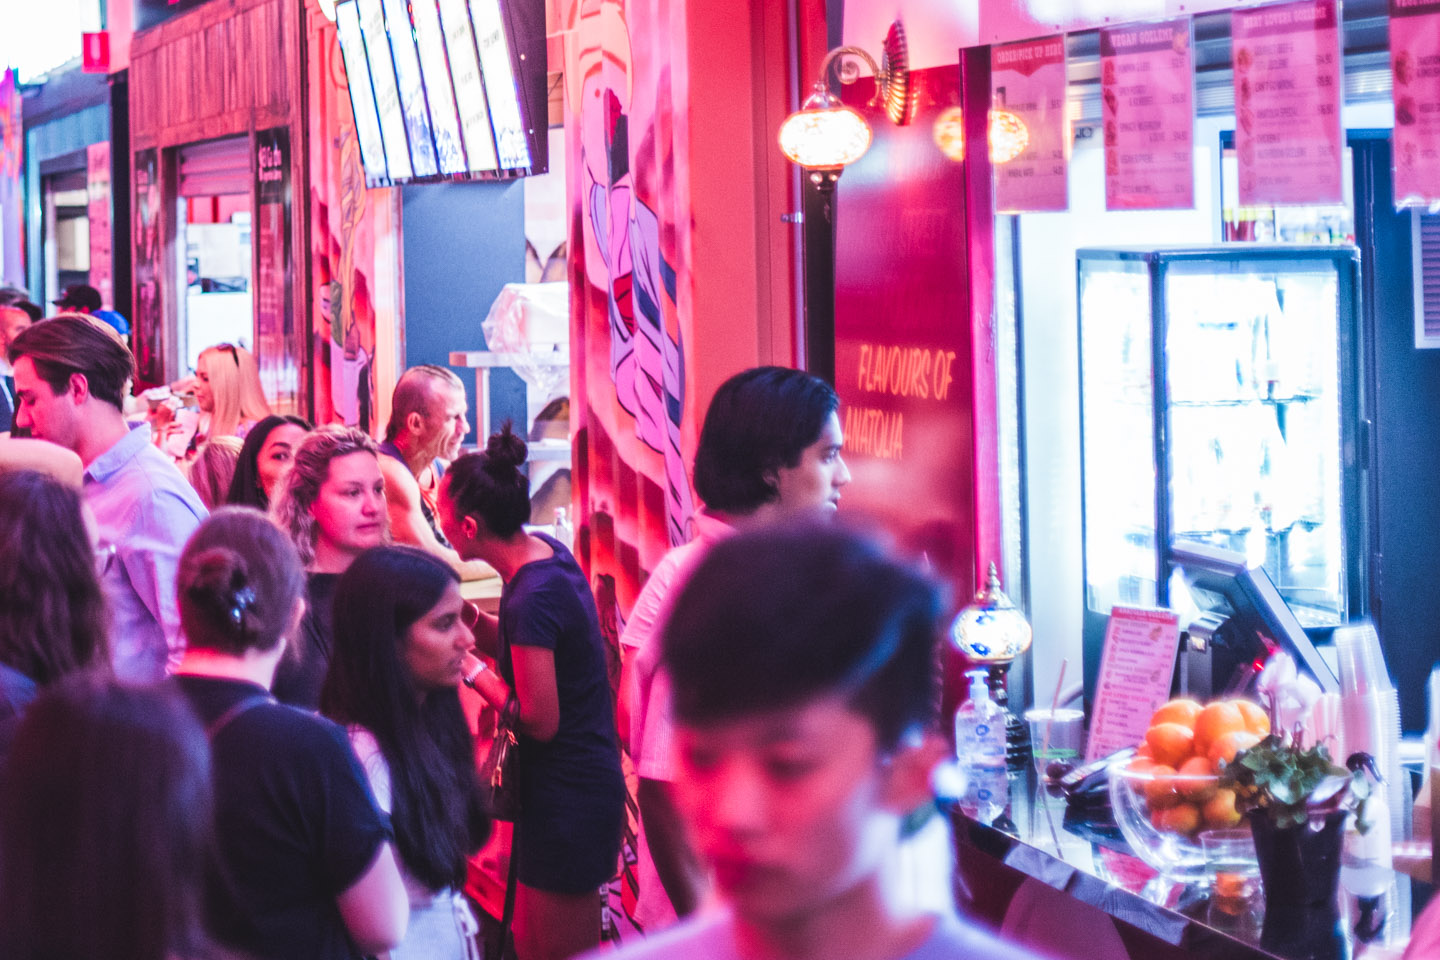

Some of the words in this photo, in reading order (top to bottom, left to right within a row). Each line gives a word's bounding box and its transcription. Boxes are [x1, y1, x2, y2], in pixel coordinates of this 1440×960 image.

[1111, 32, 1137, 47] VEGAN
[858, 344, 932, 399] FLAVOURS
[933, 349, 956, 400] OF
[843, 406, 903, 460] ANATOLIA
